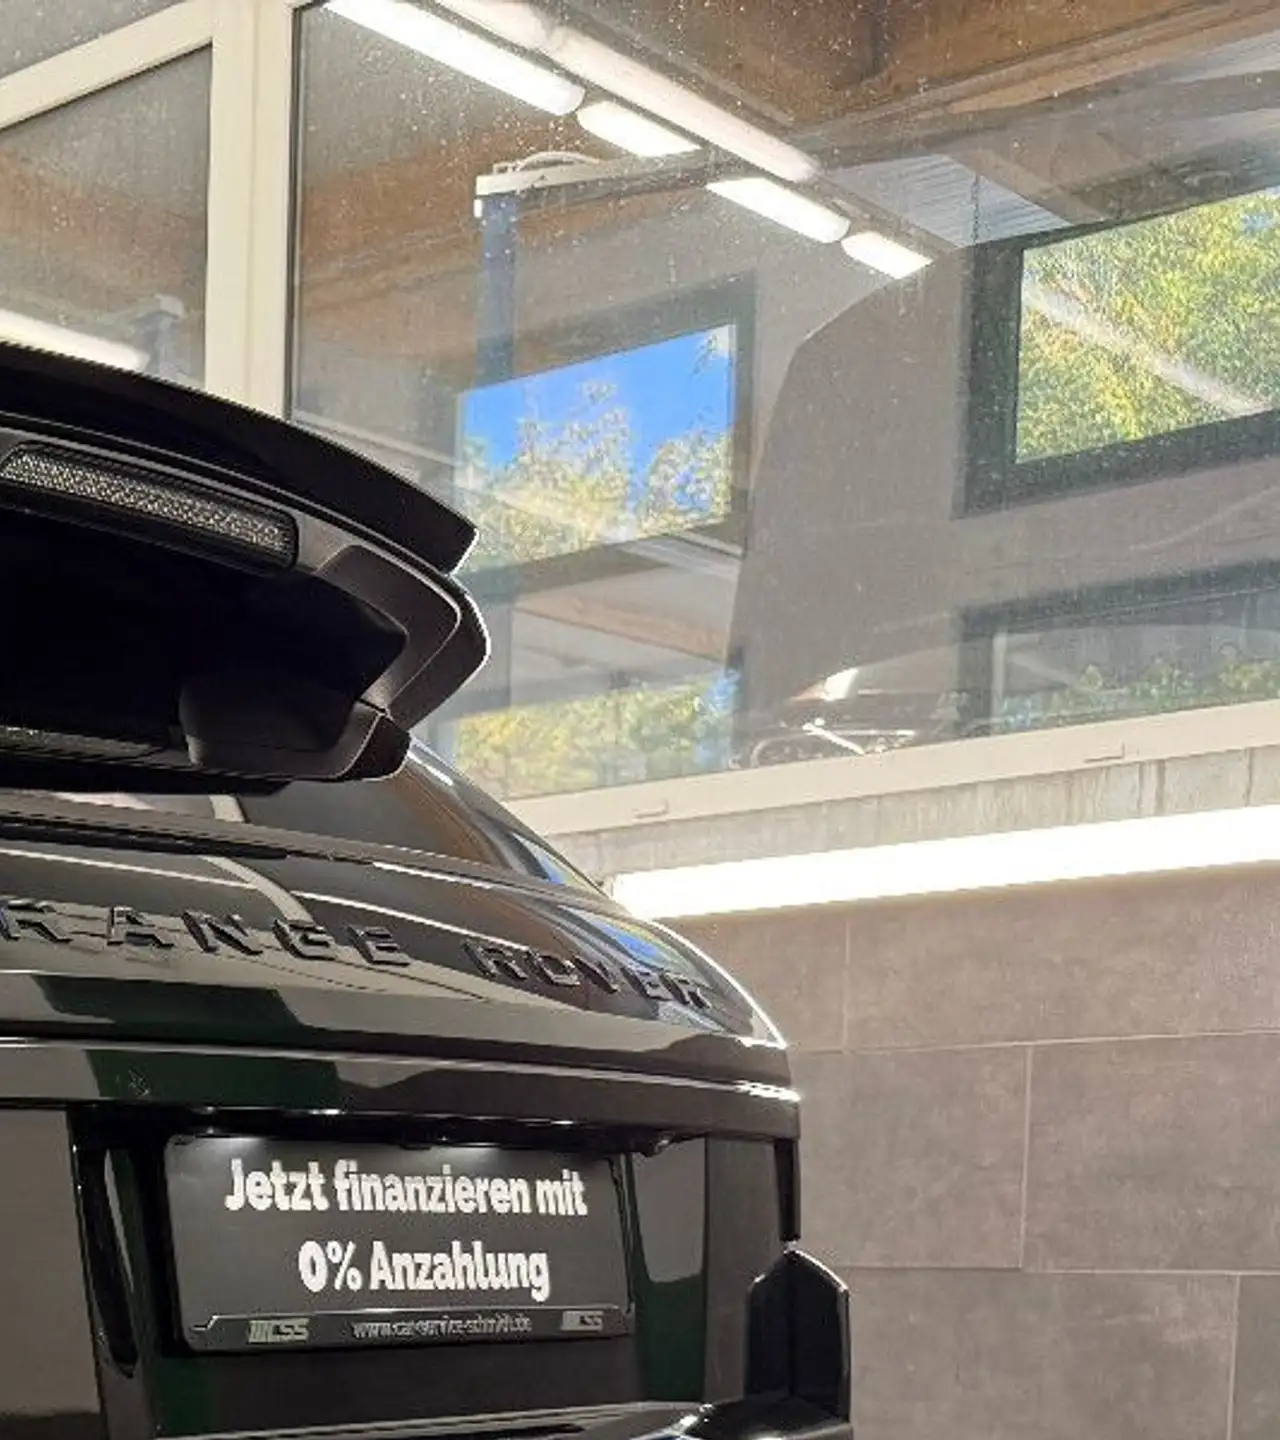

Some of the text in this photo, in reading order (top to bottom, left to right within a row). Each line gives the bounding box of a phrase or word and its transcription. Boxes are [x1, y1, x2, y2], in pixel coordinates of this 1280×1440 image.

[460, 937, 711, 1009] ROVER
[224, 1158, 589, 1217] Jetzt finanzieren mit
[297, 1240, 551, 1302] 0% Anzahlung
